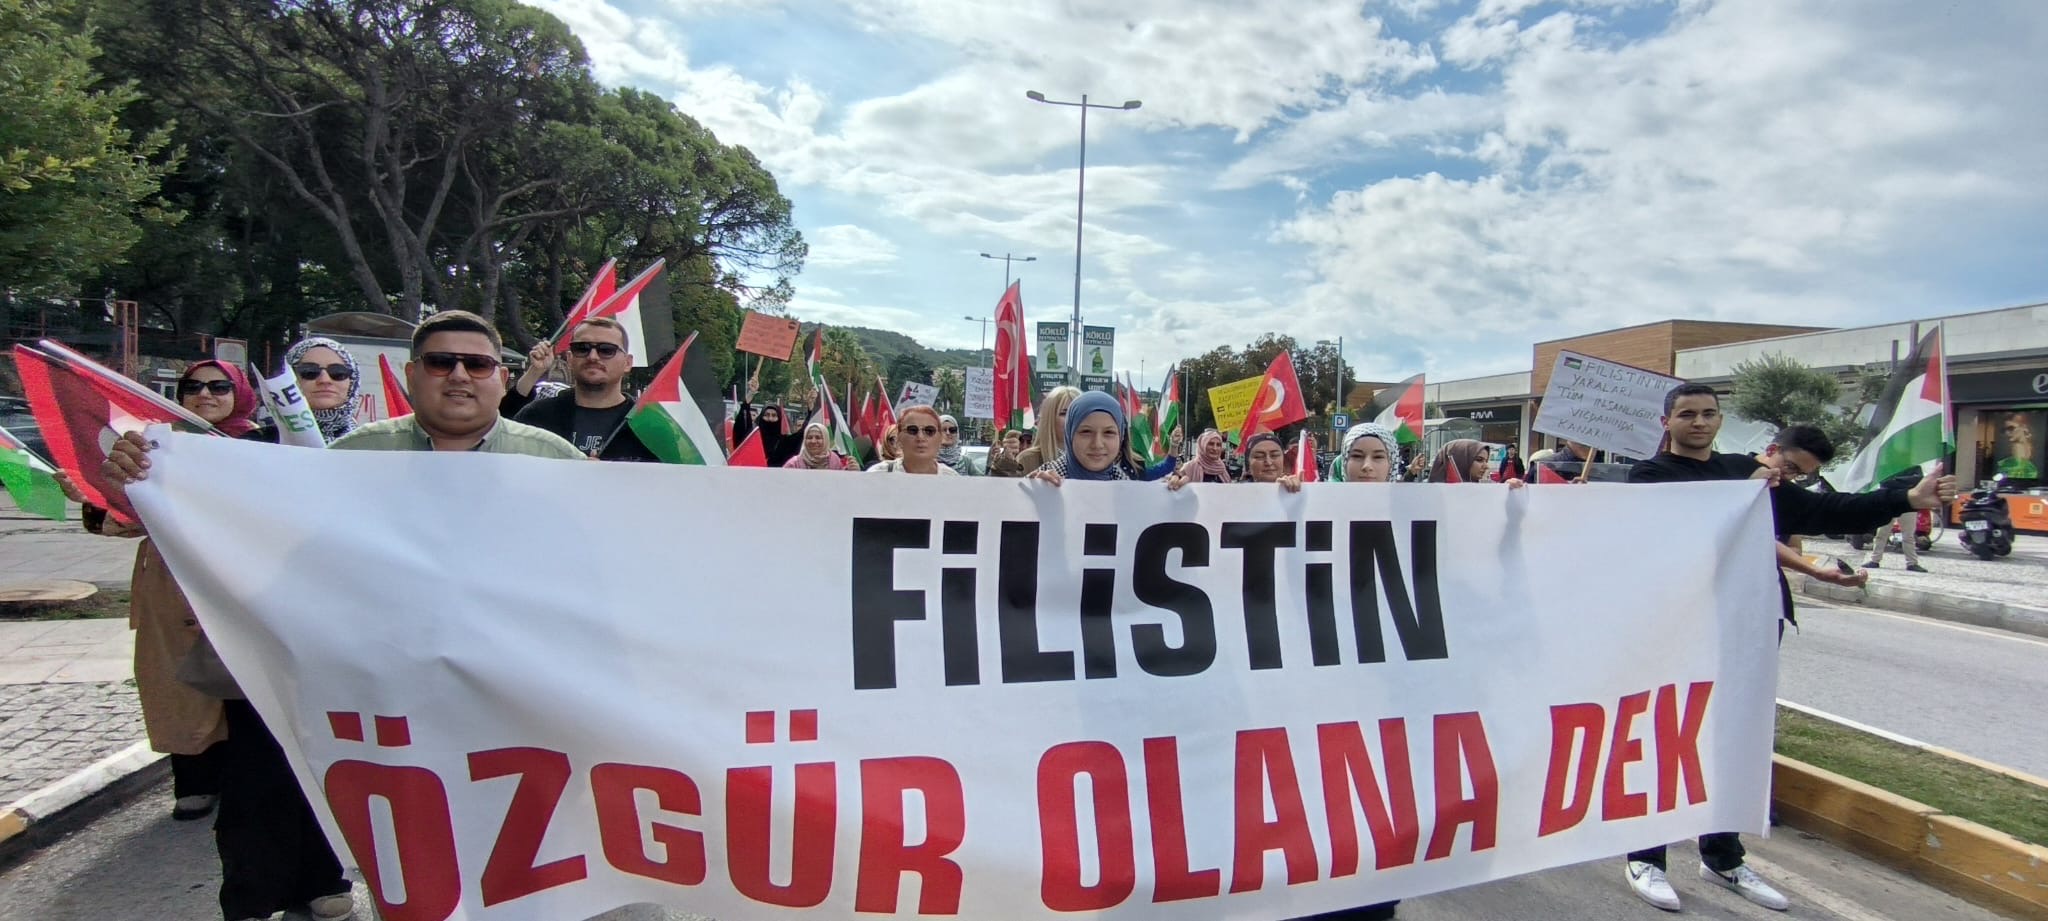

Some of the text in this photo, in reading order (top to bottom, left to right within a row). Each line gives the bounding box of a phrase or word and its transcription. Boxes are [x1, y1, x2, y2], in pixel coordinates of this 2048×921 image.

[324, 682, 1713, 921] ÖZGÜR OLANA DEK
